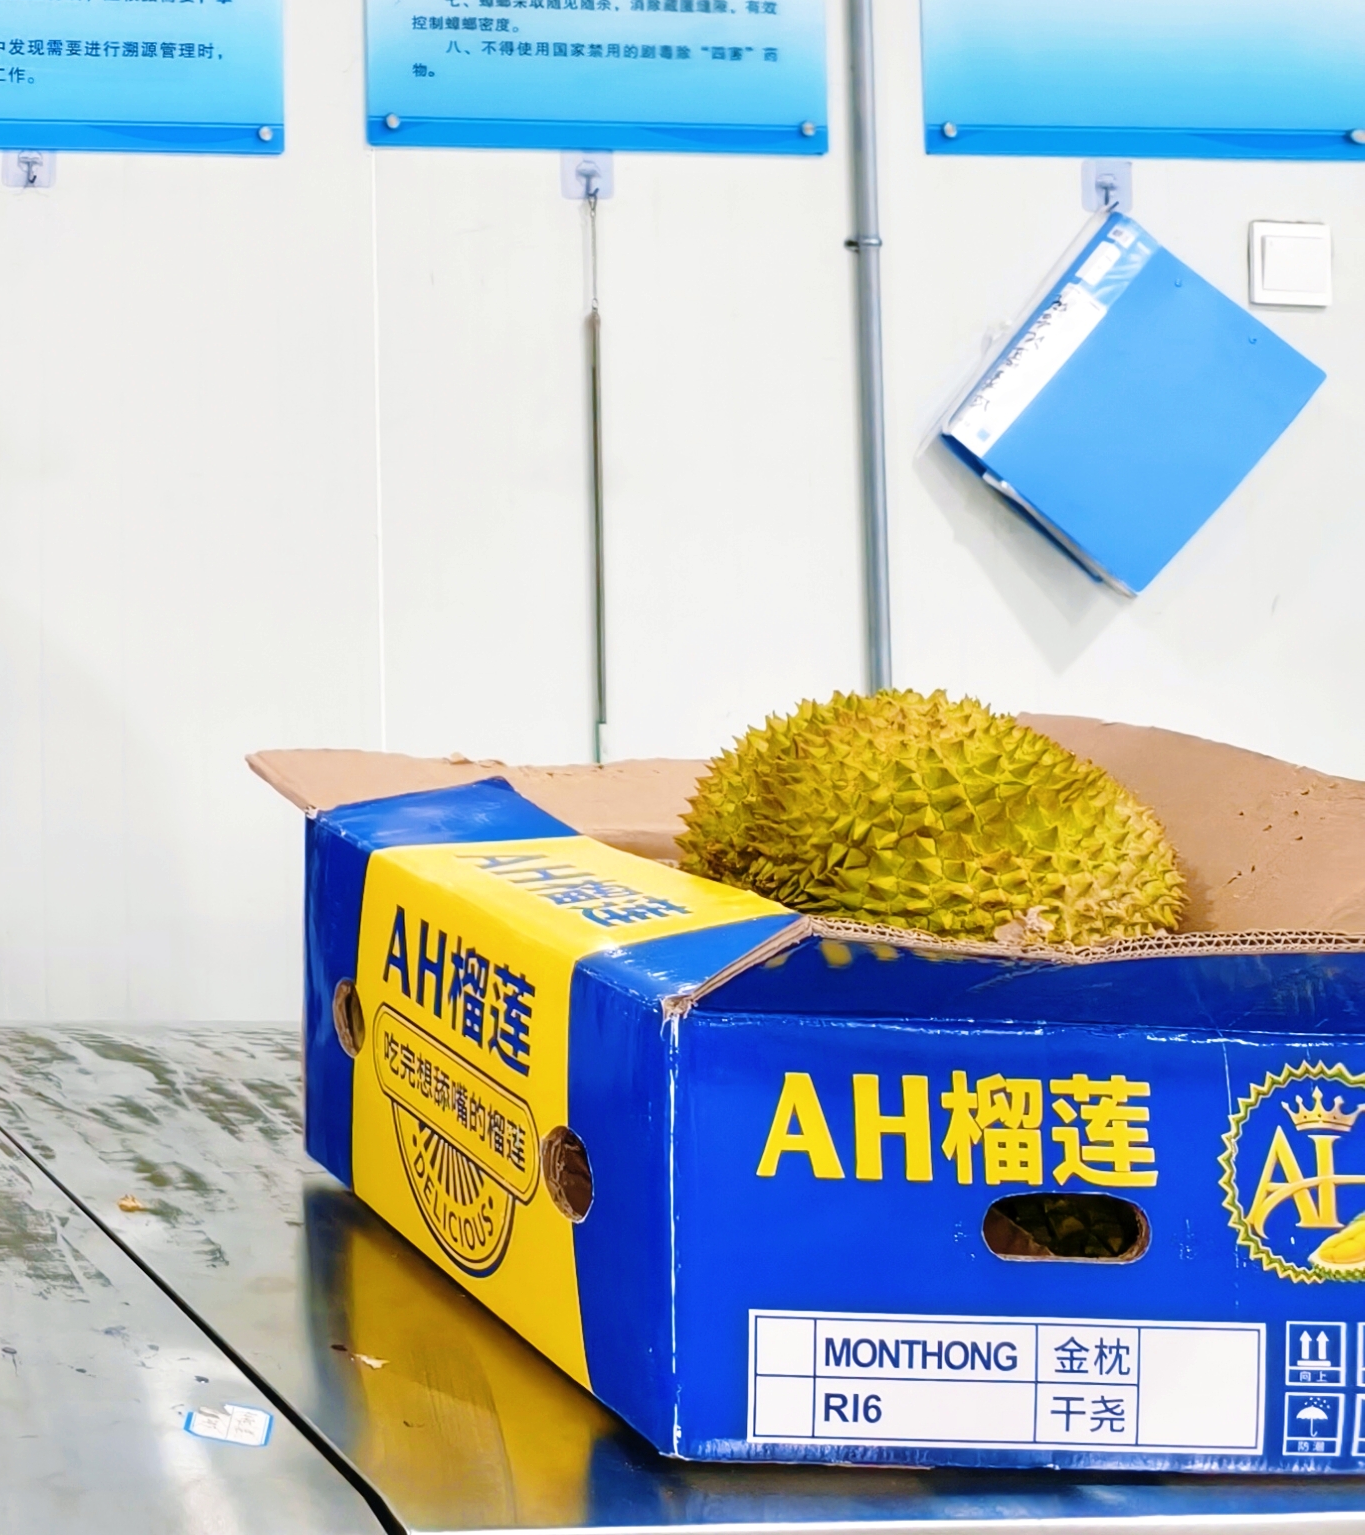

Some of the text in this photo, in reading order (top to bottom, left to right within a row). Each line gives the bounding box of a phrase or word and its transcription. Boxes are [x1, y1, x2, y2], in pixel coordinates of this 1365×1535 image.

[412, 63, 435, 77] 物。
[454, 851, 694, 927] AH榴莲
[382, 905, 536, 1077] AH榴莲
[383, 1030, 526, 1173] 吃完想舔嘴的榴莲
[756, 1070, 1159, 1189] AH榴莲
[413, 1153, 495, 1250] DELICIOUS
[824, 1336, 1132, 1377] MONTHONG 金枕
[1299, 1371, 1328, 1383] 向上
[823, 1393, 1127, 1434] RI6 干尧
